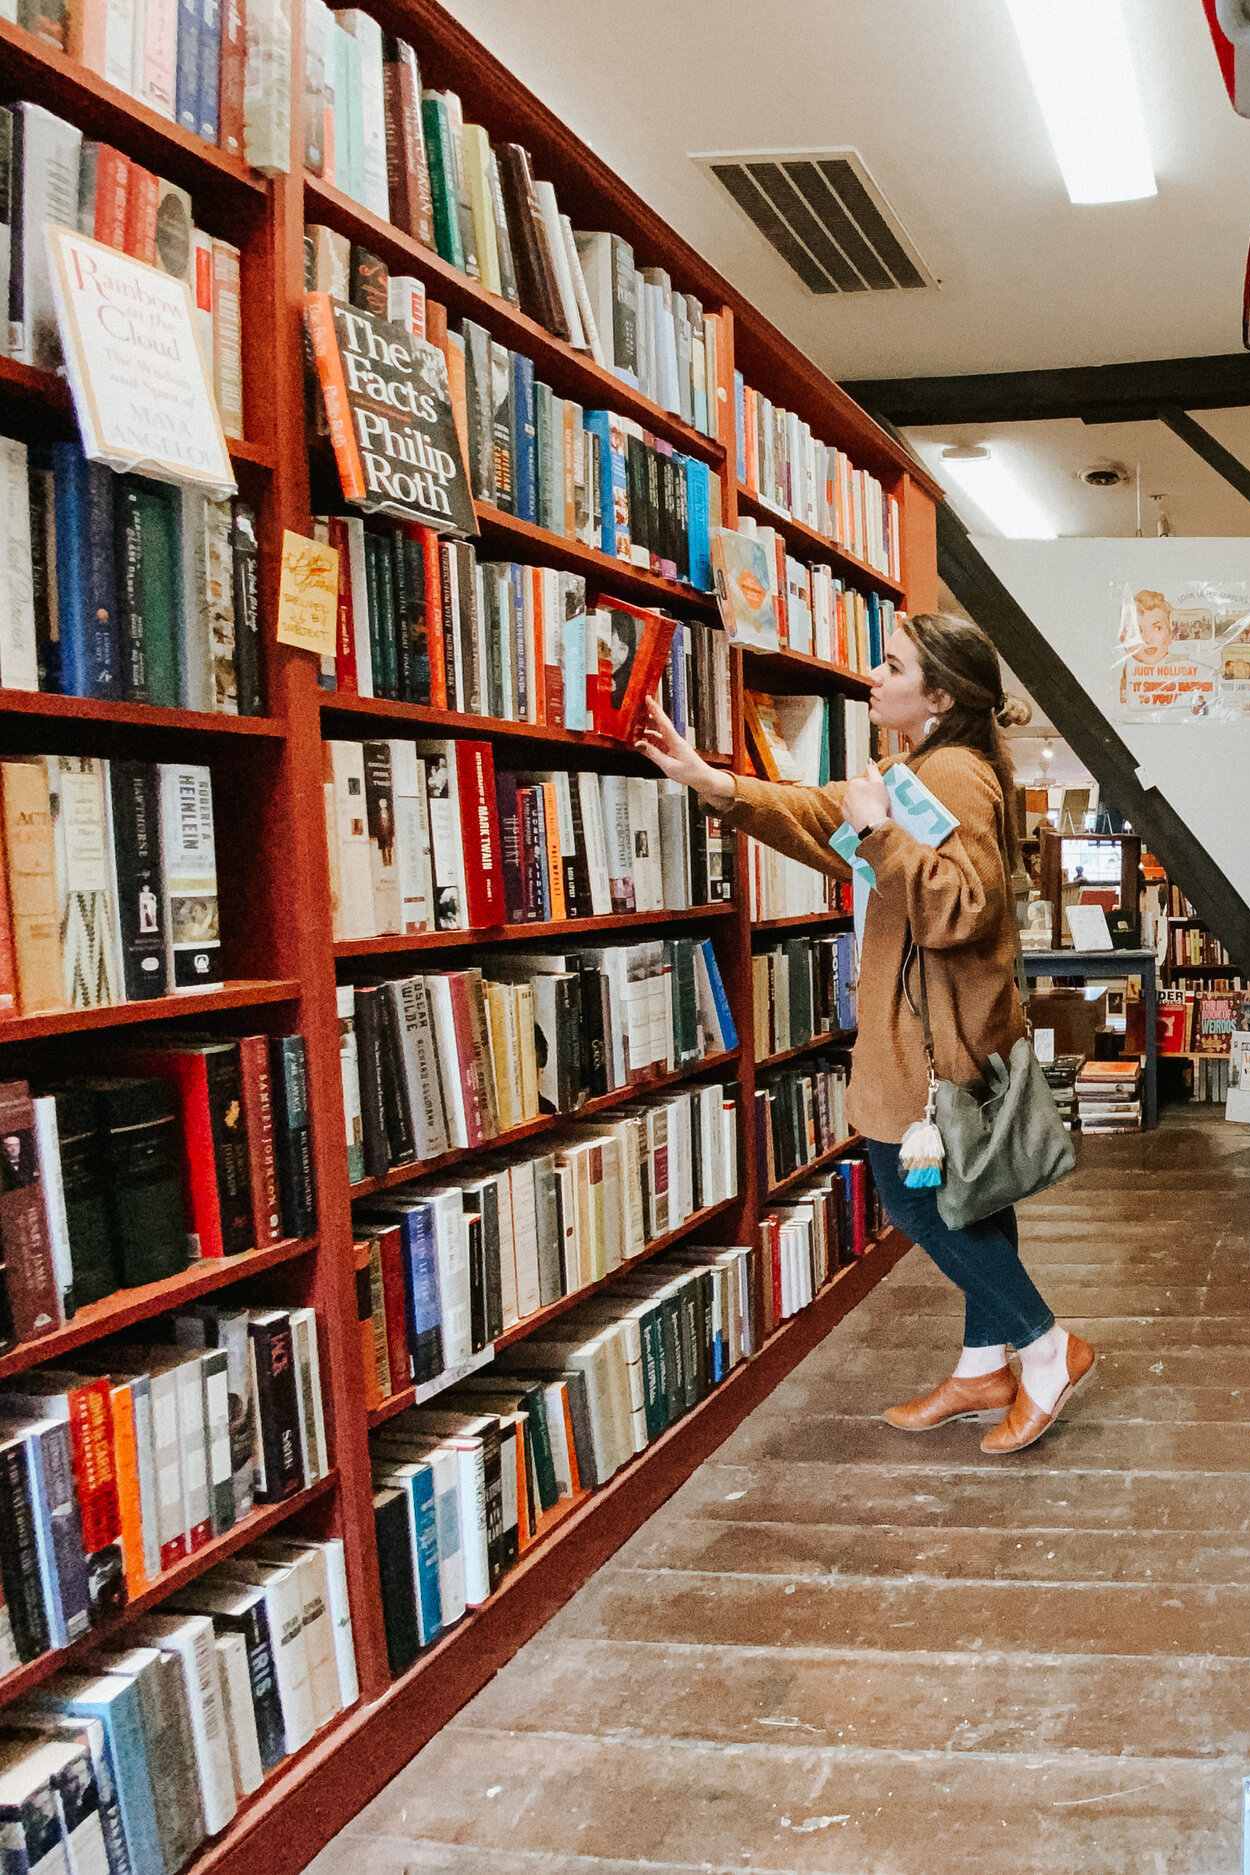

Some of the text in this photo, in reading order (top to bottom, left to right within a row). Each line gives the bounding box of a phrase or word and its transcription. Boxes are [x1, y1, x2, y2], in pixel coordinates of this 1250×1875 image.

[71, 248, 183, 320] Rainbow
[98, 303, 181, 363] Cloud
[334, 307, 411, 373] The
[343, 350, 439, 425] Facts
[355, 408, 457, 486] Philip
[362, 450, 452, 517] Roth
[1132, 666, 1198, 676] JUDY HOLLIDAY
[132, 778, 148, 857] HAWTHORNE
[179, 774, 199, 851] HEINLEIN
[198, 781, 211, 828] ROBERT
[478, 806, 490, 836] MARK
[480, 838, 492, 870] TWAIN
[401, 986, 418, 1031] WILDE
[413, 983, 428, 1028] OSCAR
[1201, 1020, 1237, 1034] WEIRDOS
[258, 1073, 277, 1208] SAMUEL JOHNSON
